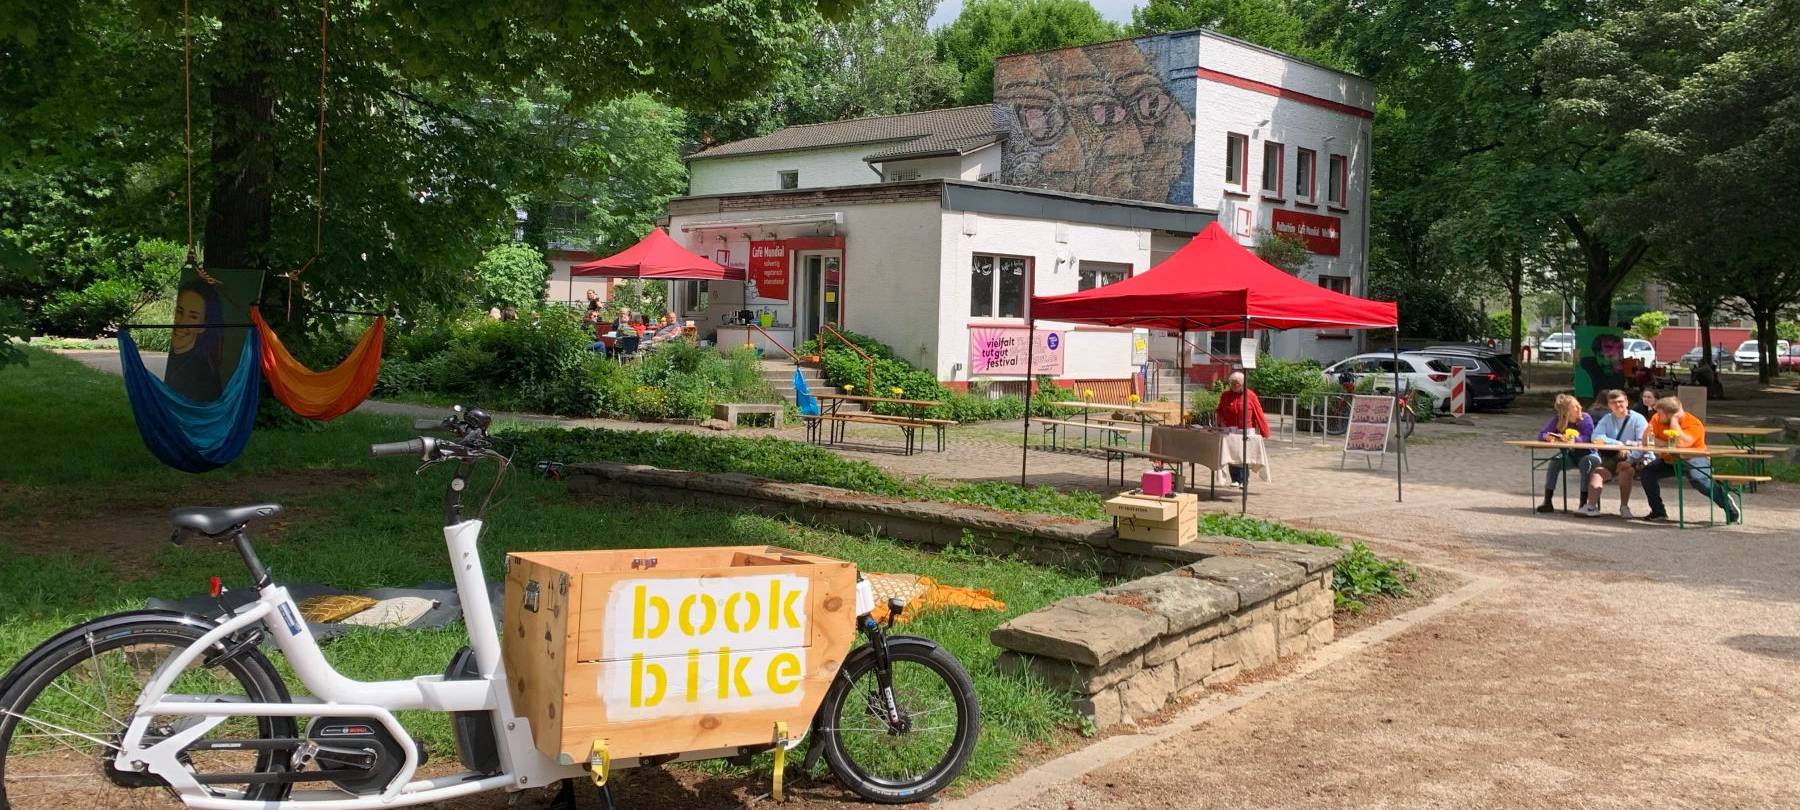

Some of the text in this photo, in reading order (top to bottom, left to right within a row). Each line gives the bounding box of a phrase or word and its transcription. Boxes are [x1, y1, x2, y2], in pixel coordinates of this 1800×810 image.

[752, 245, 784, 257] Café Mundial
[986, 337, 1015, 349] vielfalt
[986, 355, 1018, 370] festival
[632, 579, 801, 640] book
[629, 646, 801, 709] bike
